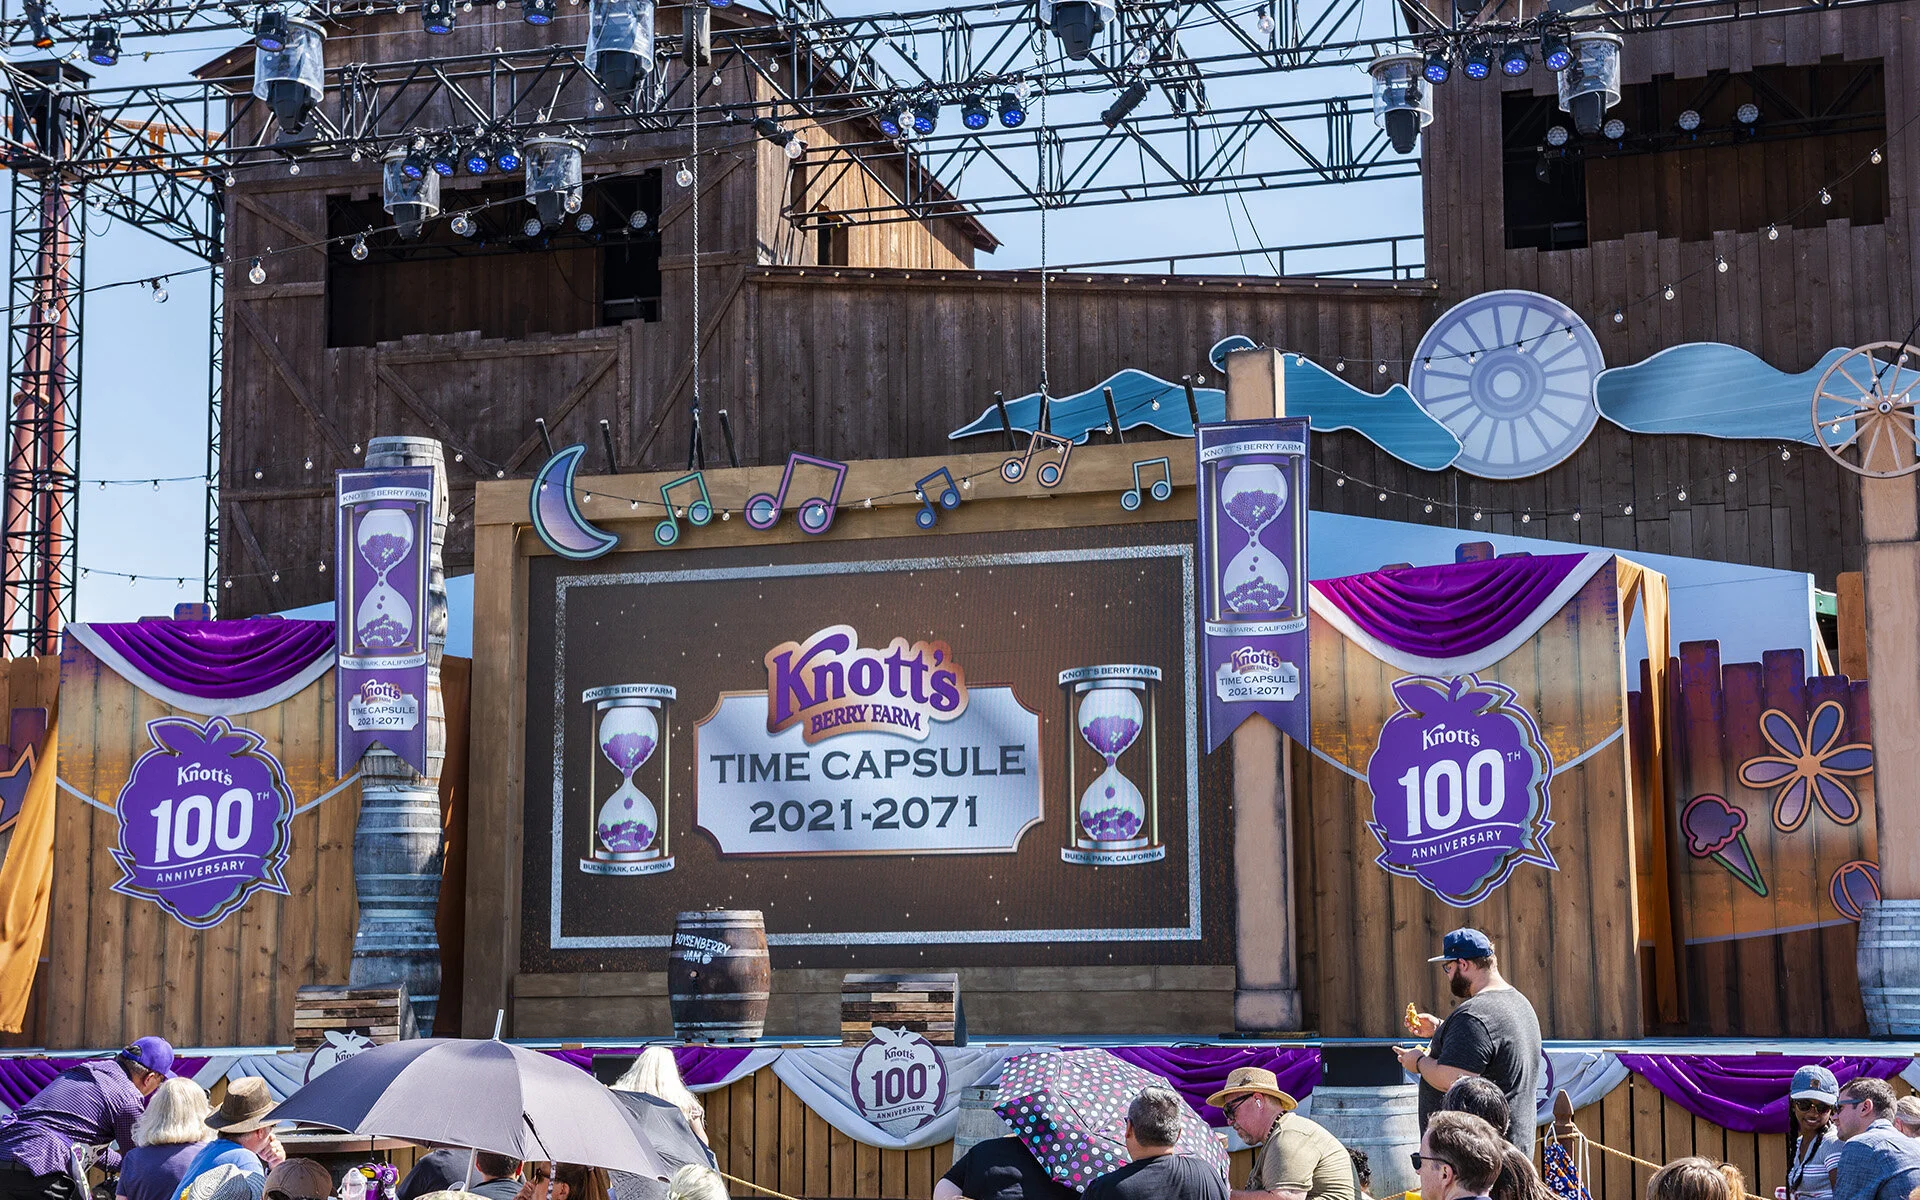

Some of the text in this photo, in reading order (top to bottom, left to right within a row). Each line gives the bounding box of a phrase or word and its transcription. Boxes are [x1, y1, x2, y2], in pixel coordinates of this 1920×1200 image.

[1204, 443, 1302, 458] KNOTT'S BERRY FARM
[377, 489, 404, 497] BERRY
[405, 490, 428, 498] FARM
[1257, 622, 1305, 632] CALIFORNIA
[1231, 648, 1280, 673] Knott's
[772, 633, 960, 725] Knott's
[1062, 667, 1158, 680] KNOTT'S BERRY FARM
[1220, 675, 1296, 686] TIME CAPSULE
[360, 680, 401, 704] Knott's
[585, 686, 673, 699] KNOTT'S BERRY FARM
[1228, 686, 1284, 697] 2021-2071
[351, 706, 416, 716] TIME CAPSULE
[357, 716, 404, 726] 2021-2071
[811, 704, 921, 735] BERRY FARM
[1422, 723, 1480, 751] Knott's
[710, 744, 1027, 783] TIME CAPSULE
[177, 762, 233, 786] Knott's
[749, 795, 978, 834] 2021-2071
[1411, 830, 1502, 858] ANNIVERSARY
[1064, 850, 1162, 863] BUENA PARK, CALIFORNIA
[156, 860, 245, 883] ANNIVERSARY
[608, 865, 629, 873] PARK,
[629, 861, 672, 872] CALIFORNIA
[675, 933, 731, 955] BOYSENBERRY
[683, 950, 701, 963] JAM
[884, 1046, 915, 1060] Knott's
[876, 1105, 925, 1119] ANNIVERSARY
